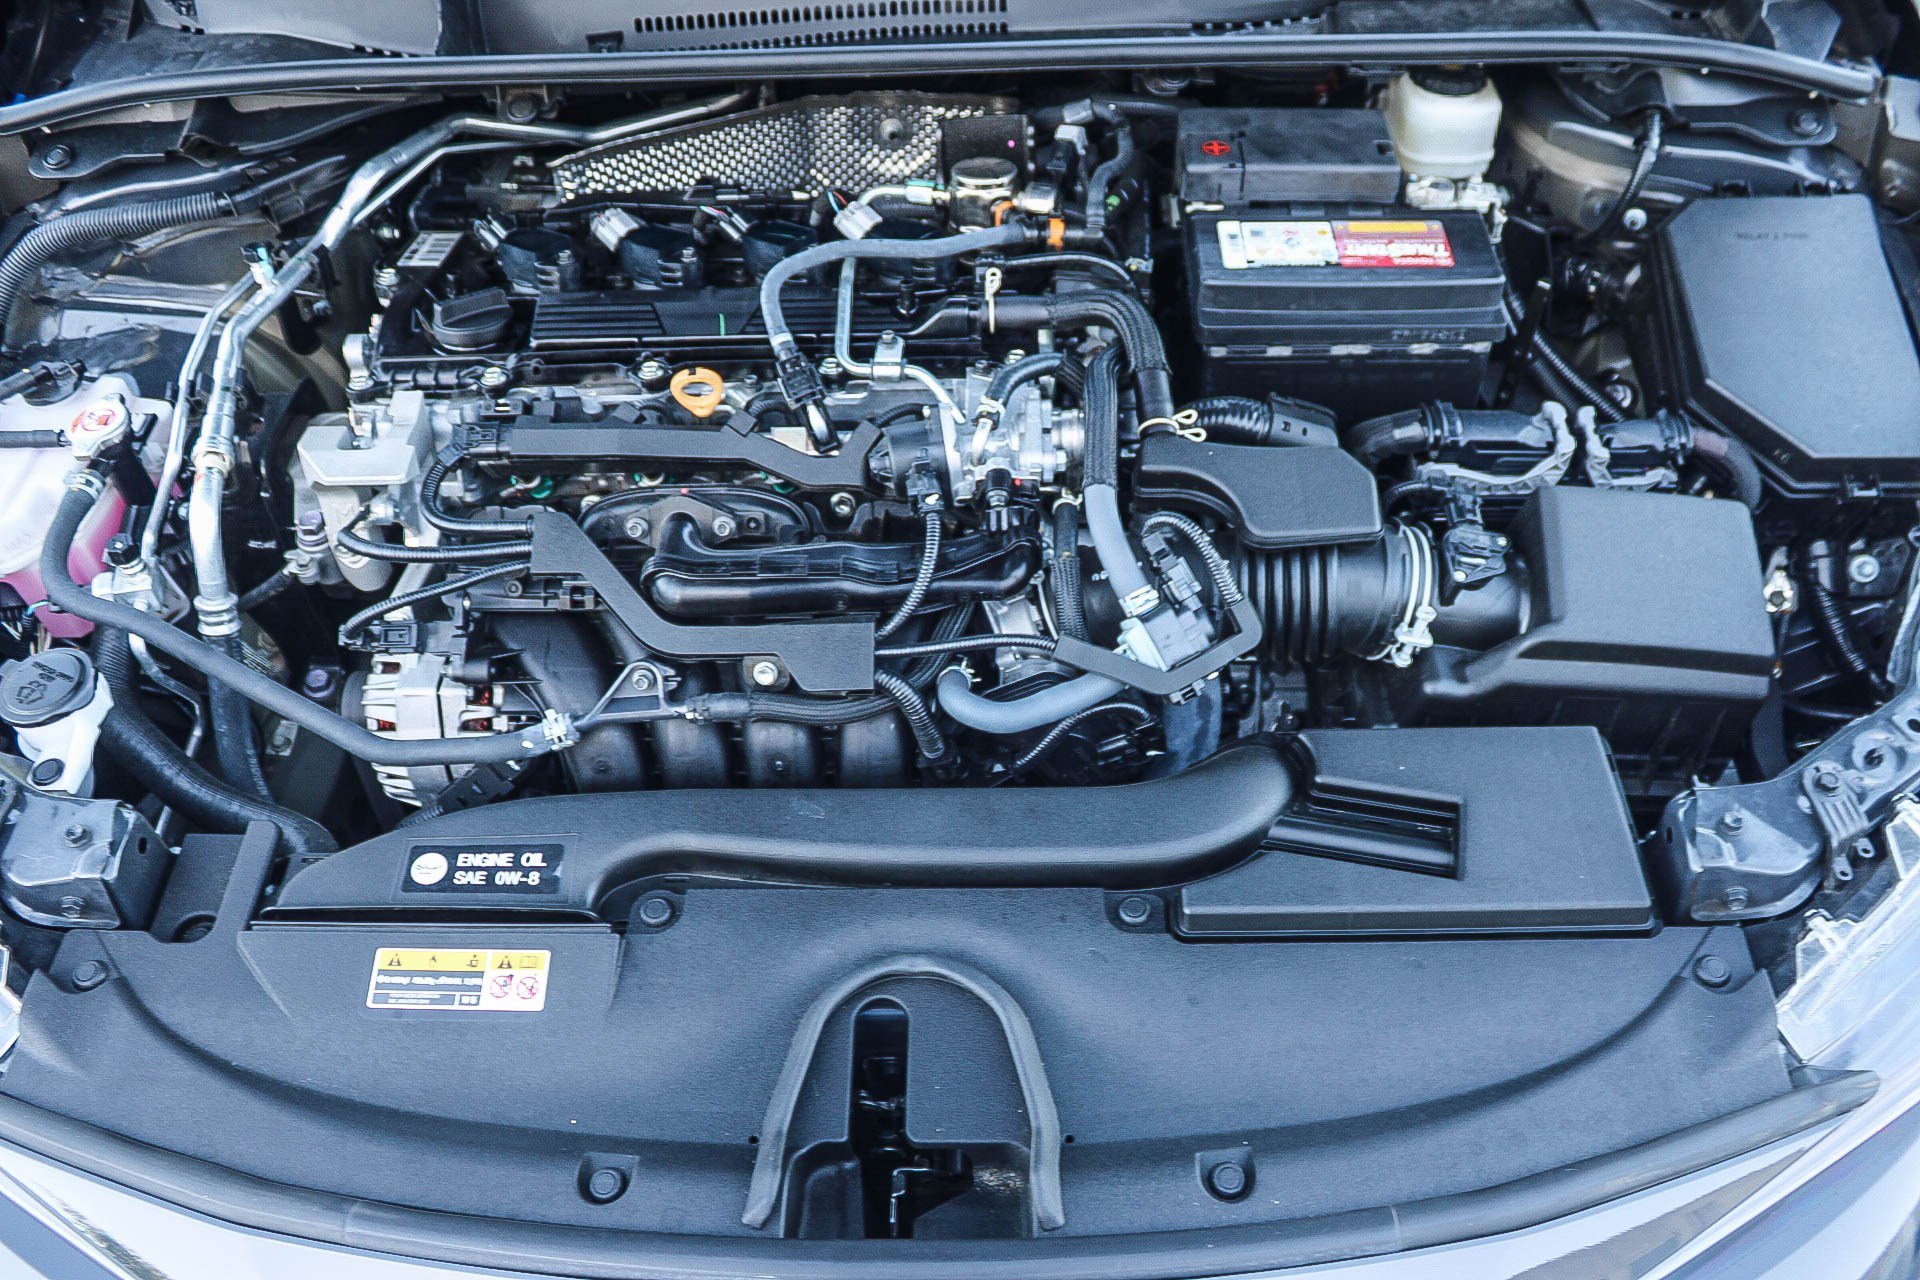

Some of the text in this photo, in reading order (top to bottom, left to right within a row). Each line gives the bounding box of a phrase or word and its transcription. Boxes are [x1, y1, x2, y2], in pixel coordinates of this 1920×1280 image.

[456, 852, 548, 867] ENGINE OIL
[452, 870, 541, 886] SAE 0W-8
